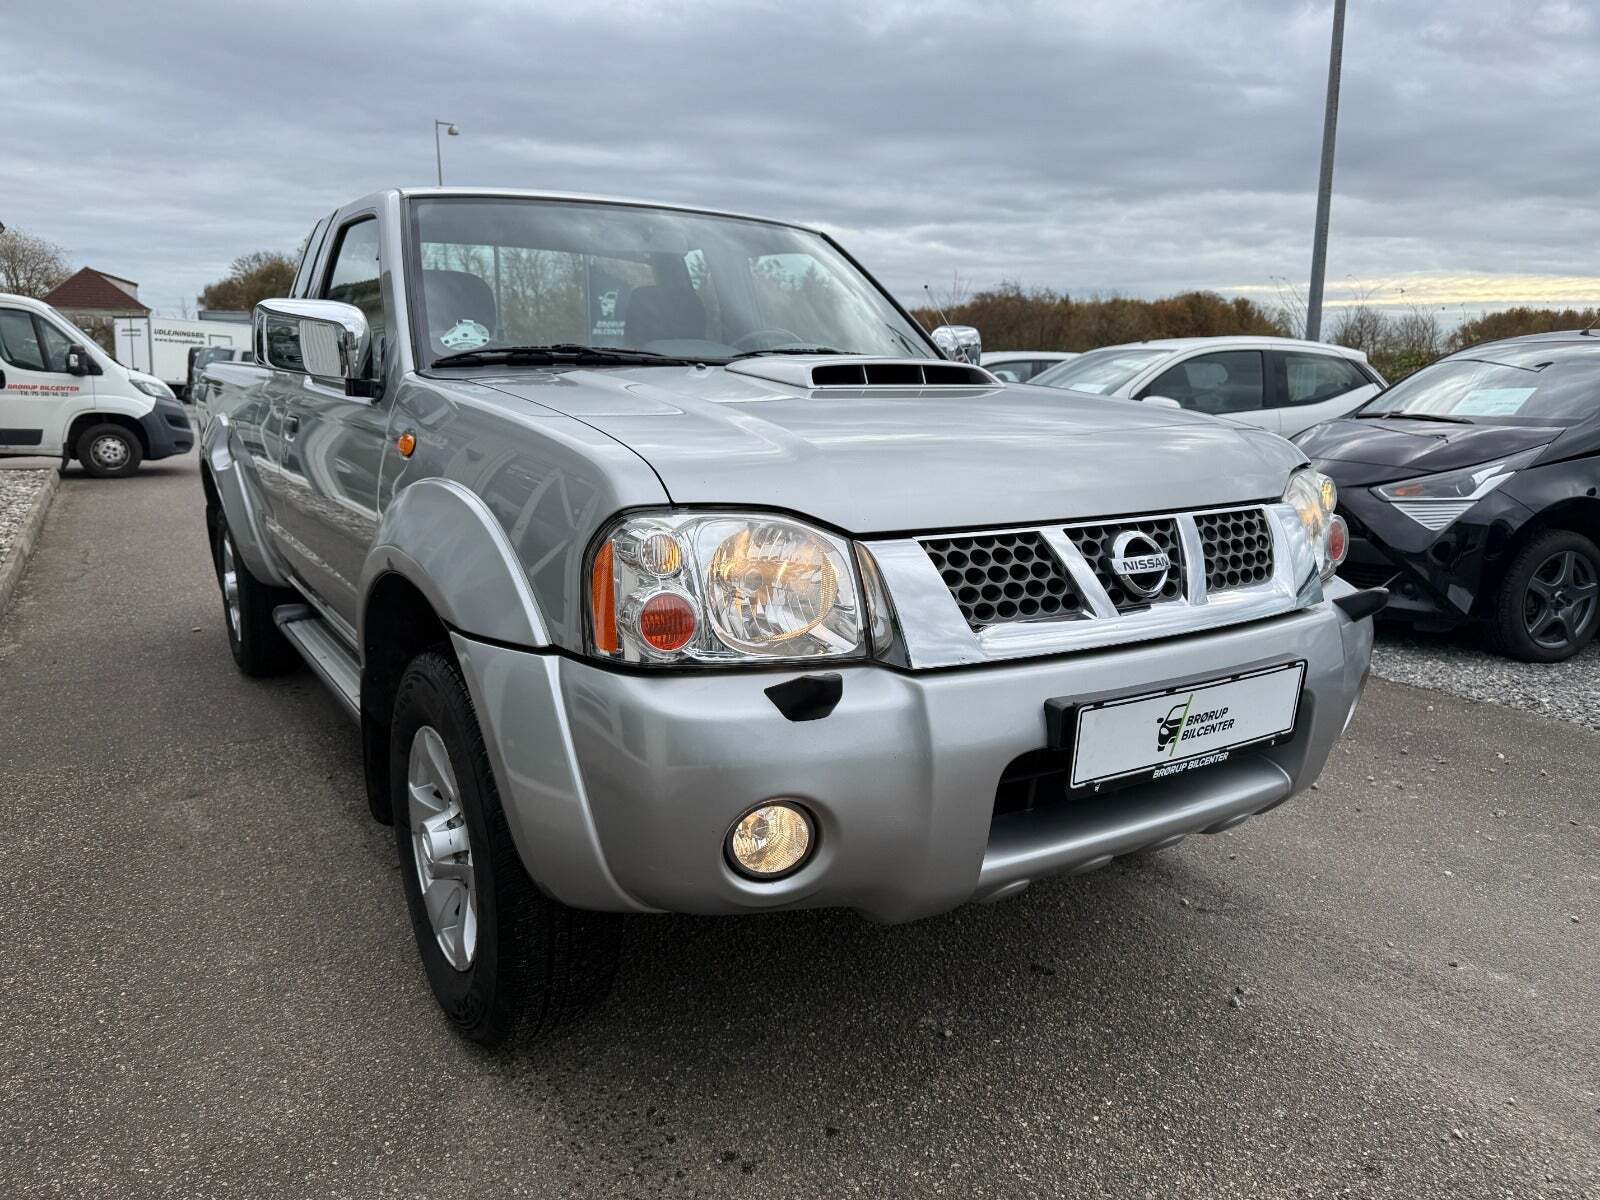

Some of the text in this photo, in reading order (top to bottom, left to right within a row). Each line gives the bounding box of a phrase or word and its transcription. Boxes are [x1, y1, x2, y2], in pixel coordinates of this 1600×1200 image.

[1122, 556, 1169, 571] NISSAN
[1186, 707, 1229, 726] BRØRUP
[1181, 718, 1235, 741] BILCENTER
[1152, 751, 1229, 779] BRØRUP BILCENTER
